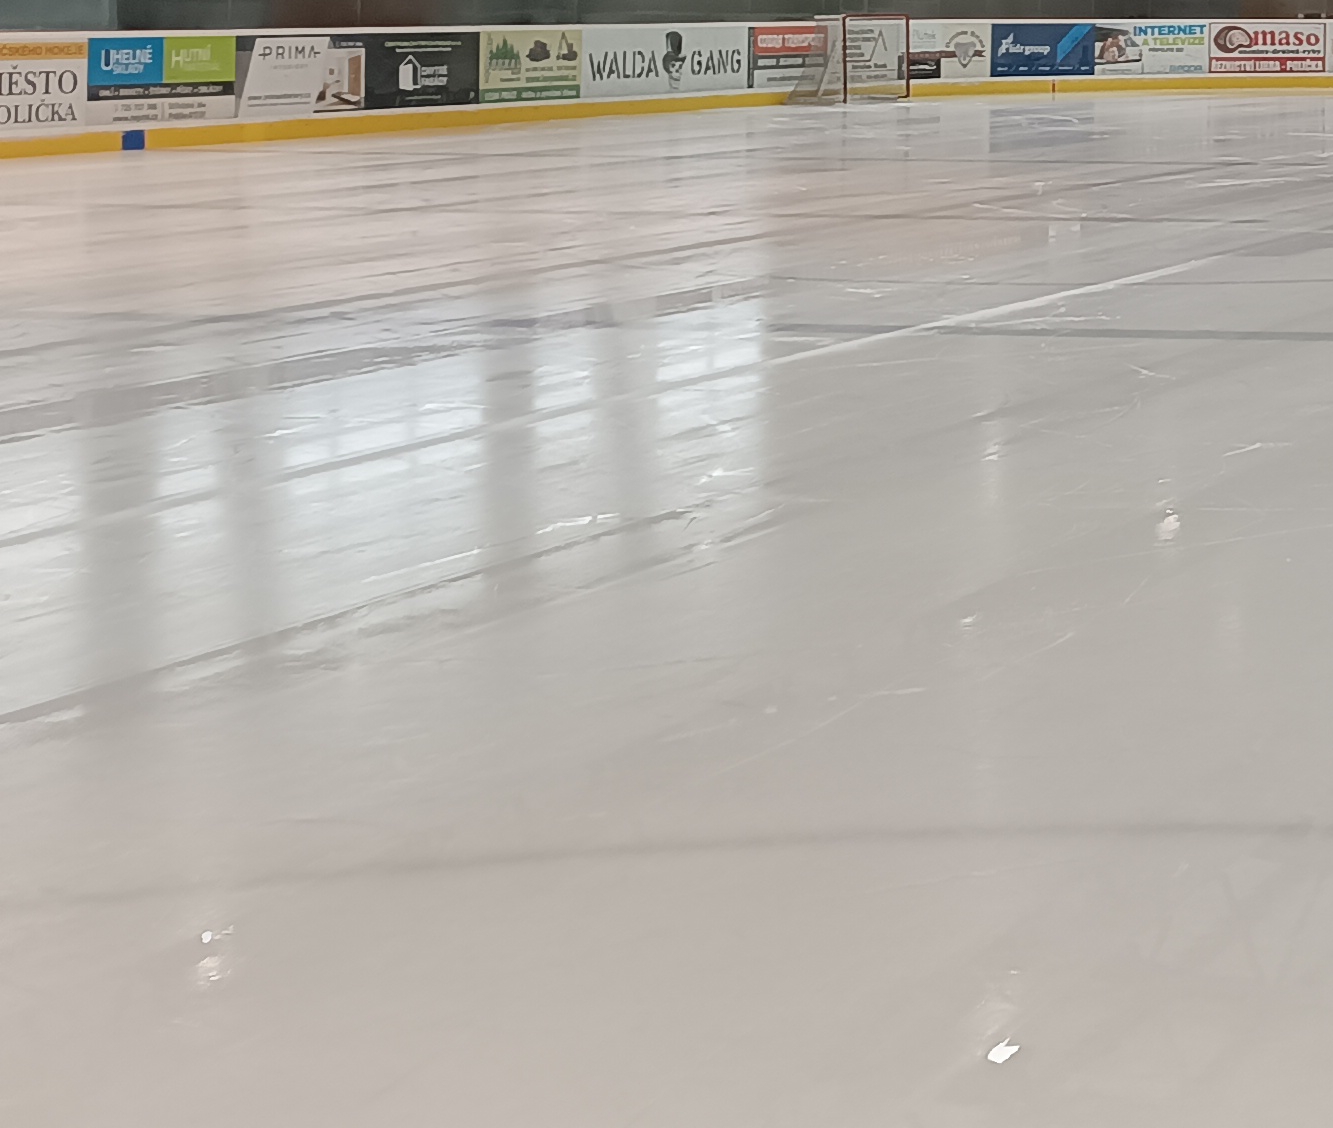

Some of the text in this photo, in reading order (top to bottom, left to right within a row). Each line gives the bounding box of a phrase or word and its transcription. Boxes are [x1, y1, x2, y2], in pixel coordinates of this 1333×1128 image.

[1133, 24, 1207, 37] INTERNET
[1252, 29, 1321, 47] maso
[1142, 37, 1205, 46] A TELEVIZE
[101, 44, 153, 71] UHELNÉ
[258, 44, 321, 61] PRIMA
[588, 50, 660, 81] WALDA
[690, 49, 742, 75] GANG
